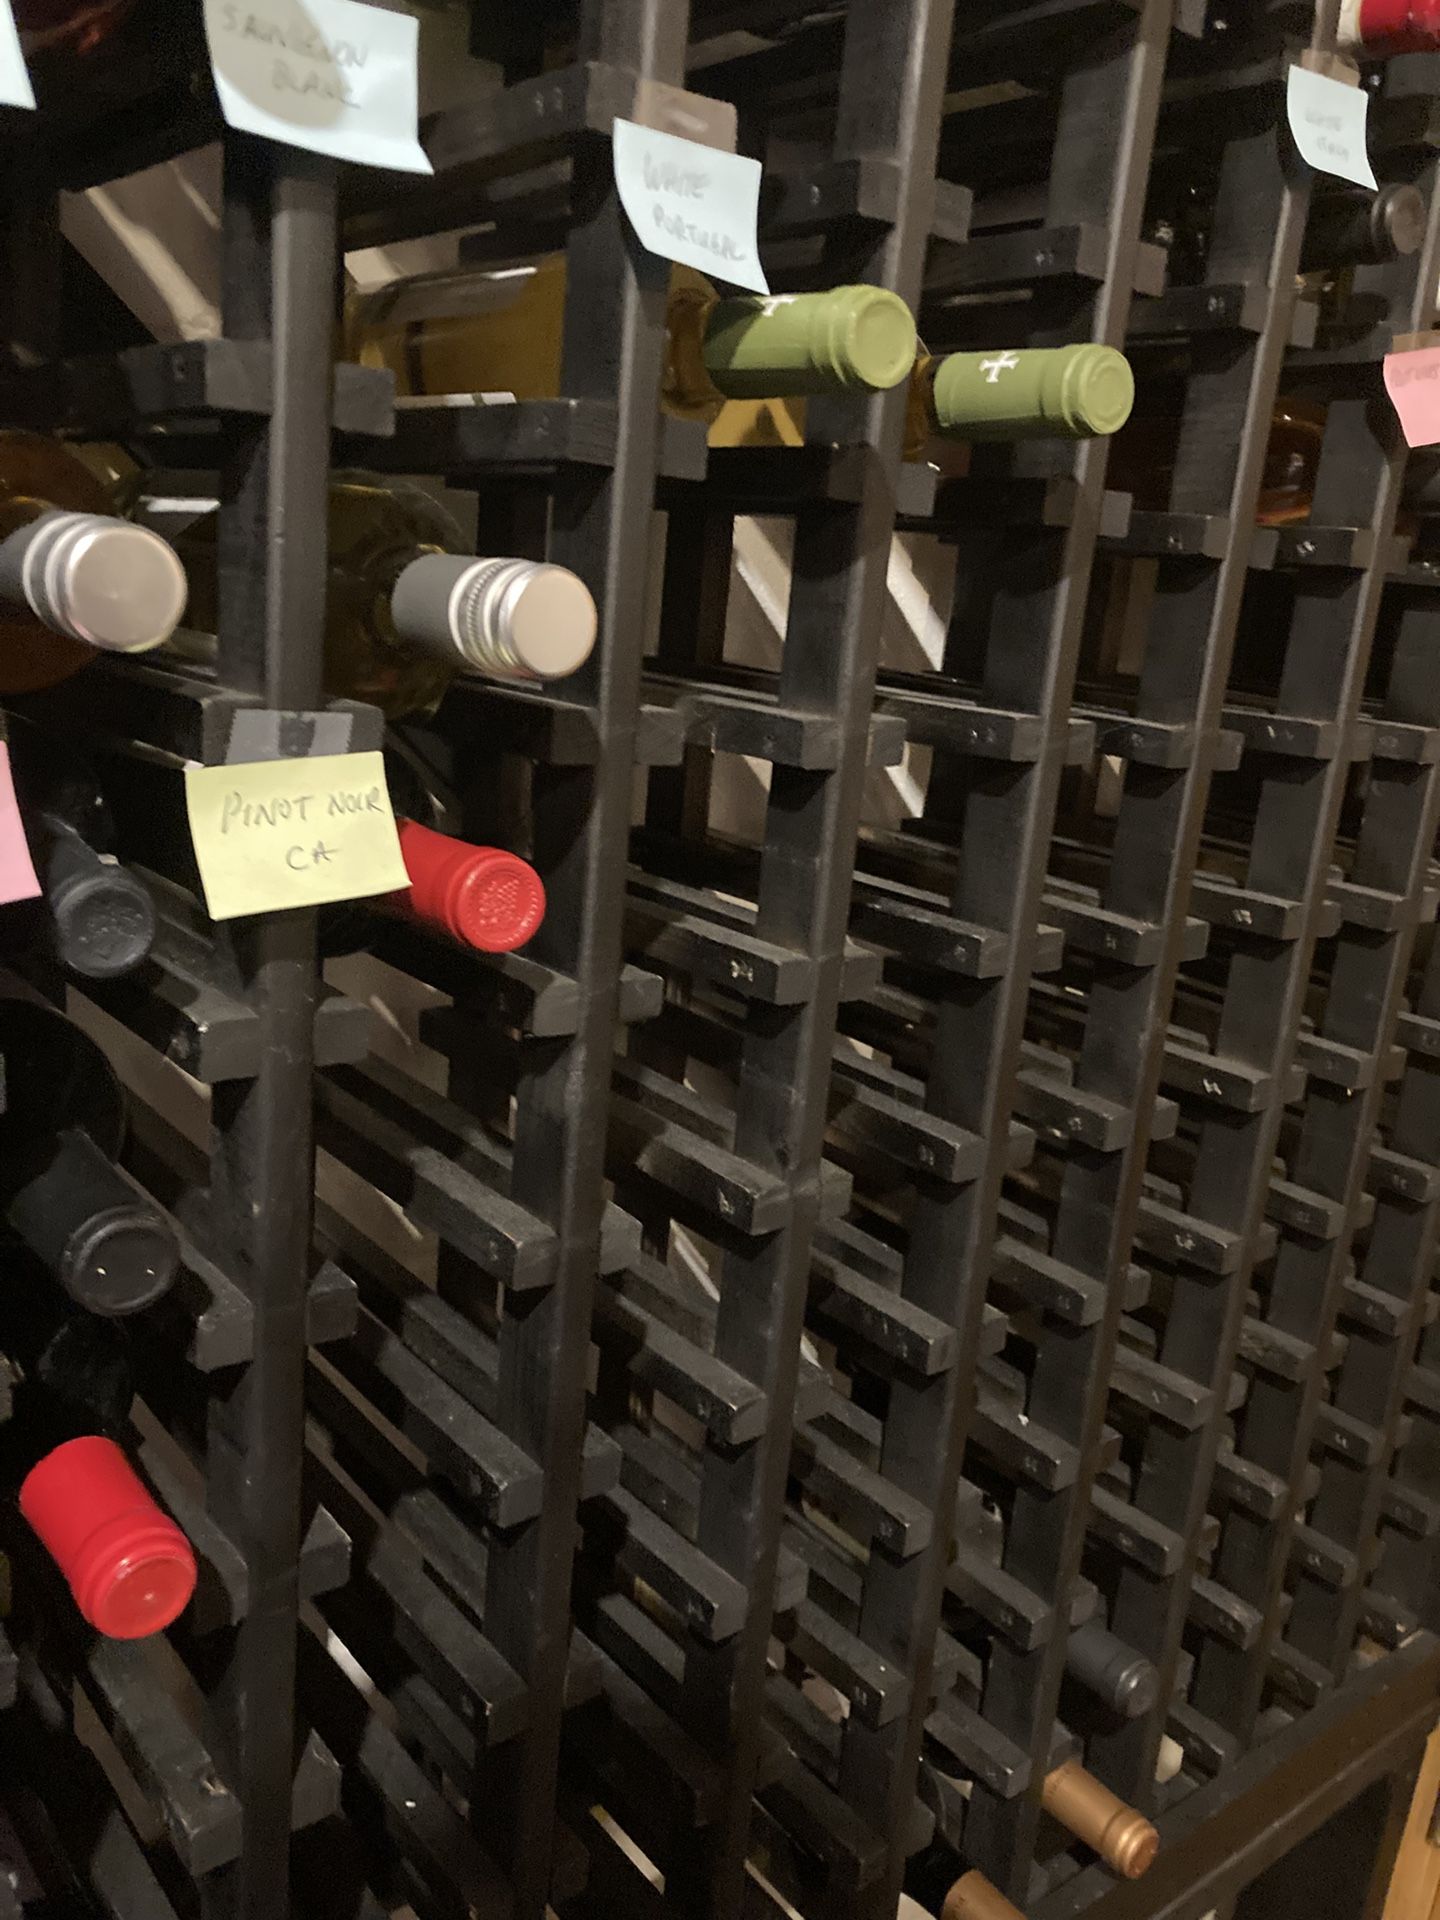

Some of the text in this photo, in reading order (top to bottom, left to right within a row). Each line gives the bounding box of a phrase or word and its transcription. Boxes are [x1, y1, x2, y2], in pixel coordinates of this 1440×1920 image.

[221, 786, 385, 835] PINOT NOIR
[285, 840, 341, 871] CA
